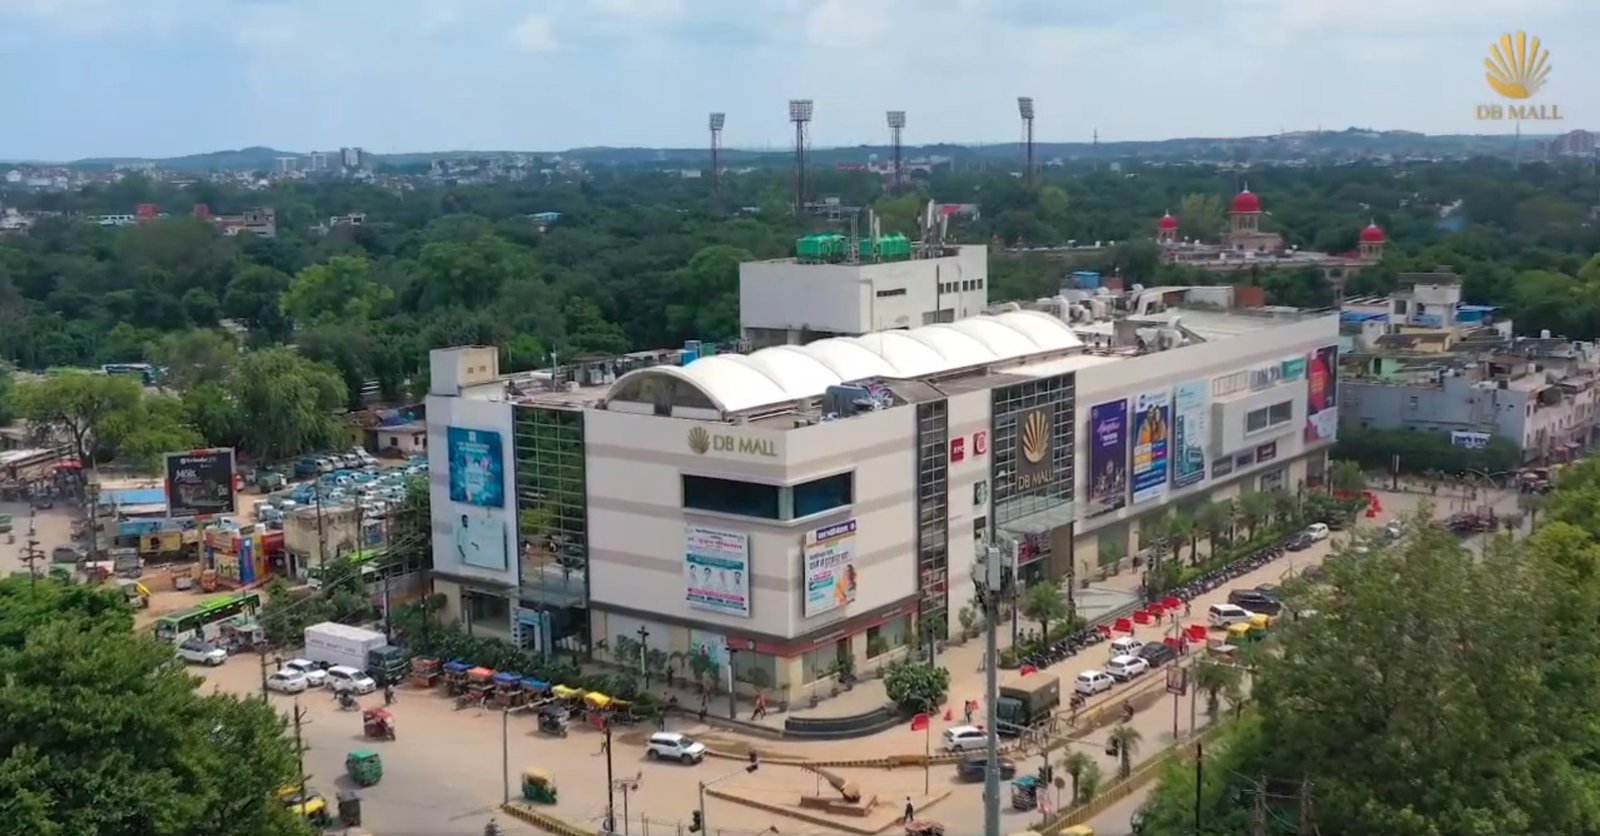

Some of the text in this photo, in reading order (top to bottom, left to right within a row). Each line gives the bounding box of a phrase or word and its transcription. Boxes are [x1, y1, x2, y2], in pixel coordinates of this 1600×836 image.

[713, 434, 778, 457] DB MALL
[953, 446, 965, 455] KFC
[1018, 469, 1053, 490] DB MALL
